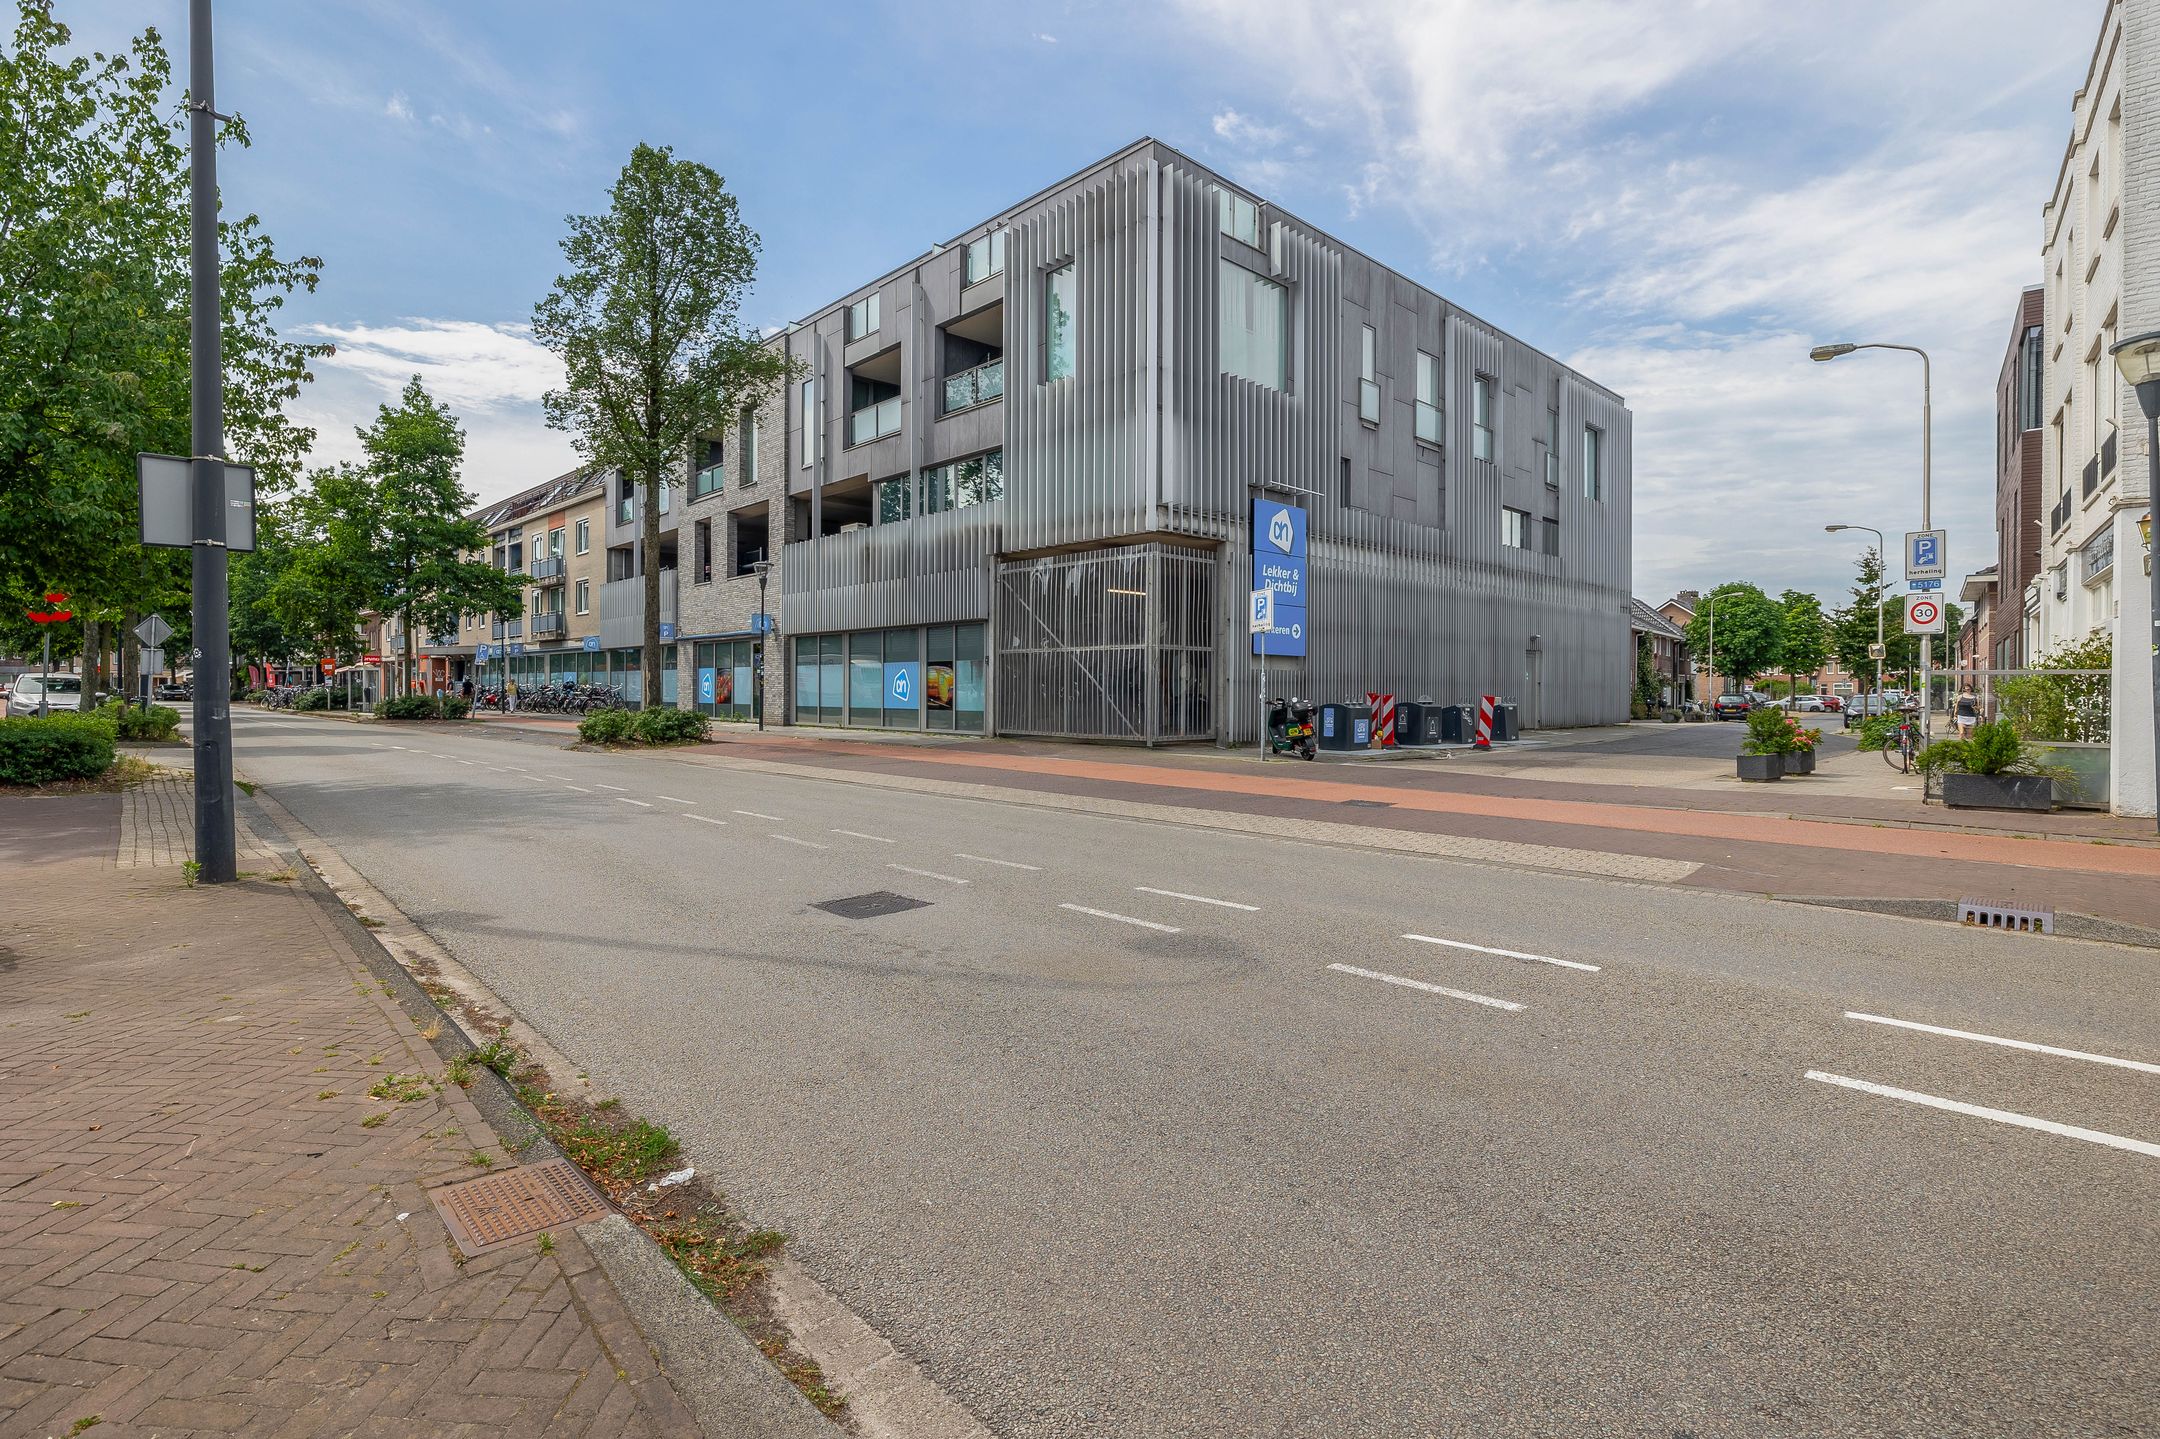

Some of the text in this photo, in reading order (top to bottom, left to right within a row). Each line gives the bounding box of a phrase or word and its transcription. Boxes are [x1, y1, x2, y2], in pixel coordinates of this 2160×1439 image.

[1919, 541, 1932, 555] P
[1263, 565, 1300, 581] Lekker &
[1265, 579, 1298, 596] Dichtbij
[1917, 580, 1940, 588] 5176
[1258, 599, 1265, 611] P
[1915, 608, 1933, 617] 30
